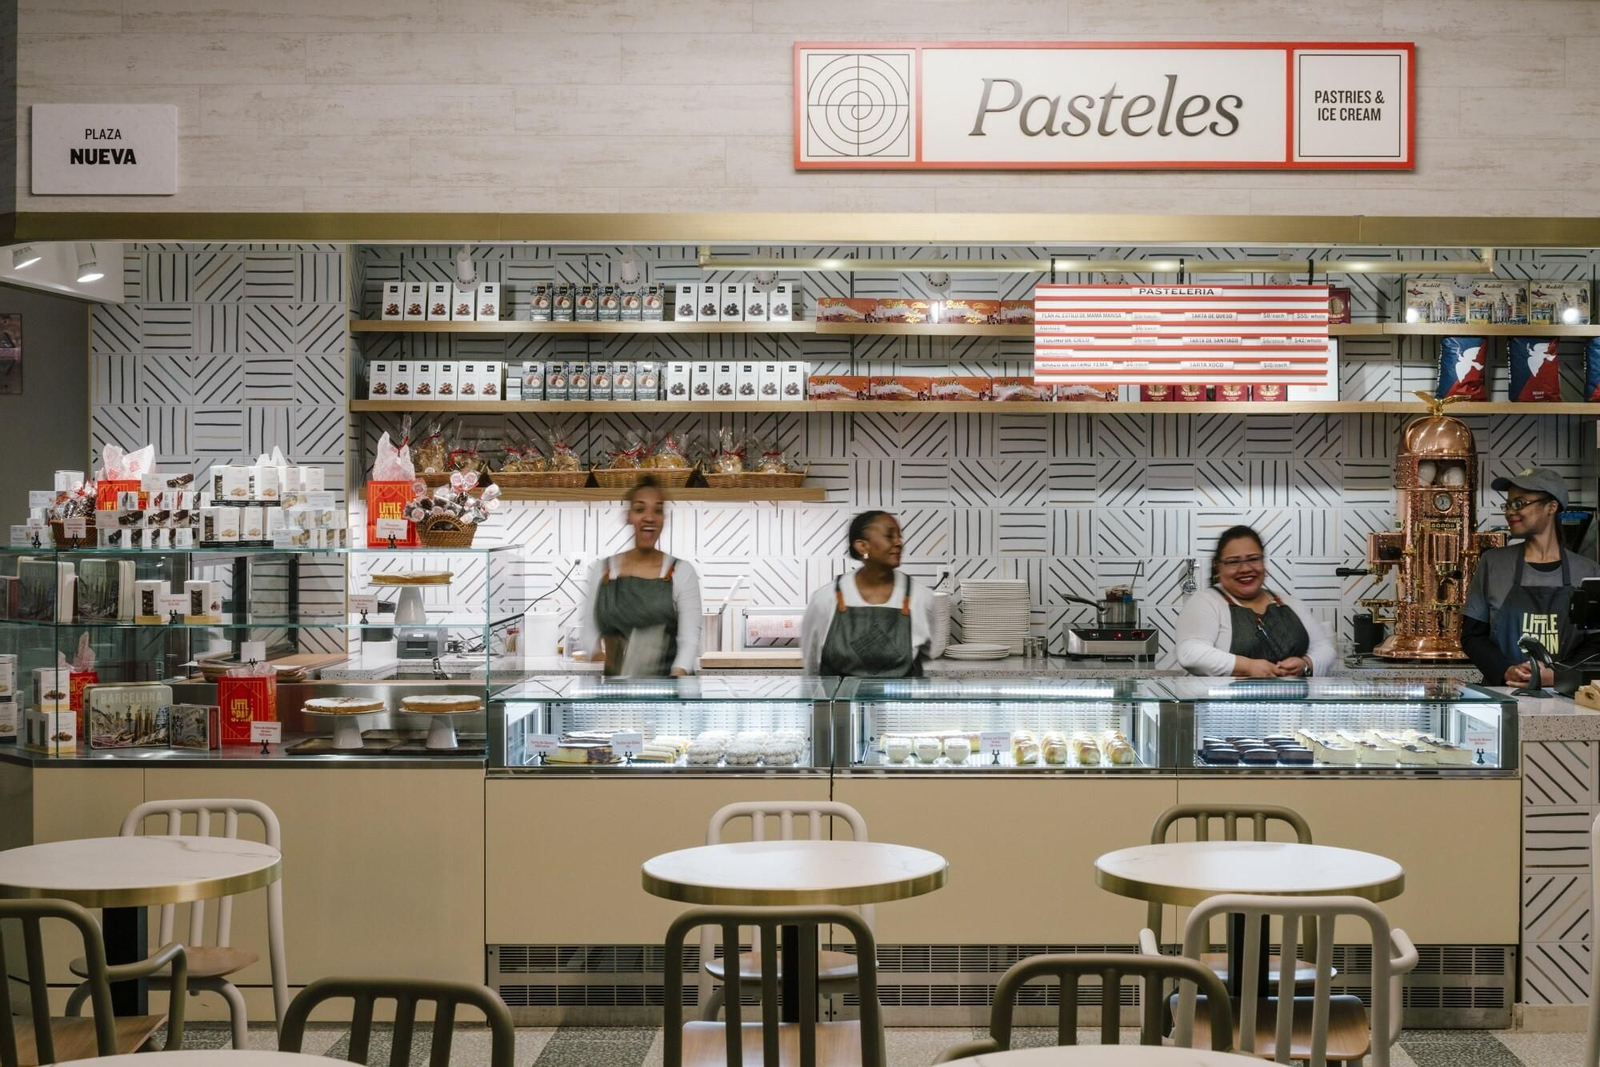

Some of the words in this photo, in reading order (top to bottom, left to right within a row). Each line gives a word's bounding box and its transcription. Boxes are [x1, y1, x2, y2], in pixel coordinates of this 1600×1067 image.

[1314, 90, 1372, 104] PASTRIES
[1374, 90, 1385, 104] &
[969, 74, 1243, 138] Pasteles
[1317, 107, 1337, 121] ICE
[1339, 107, 1381, 121] CREAM
[84, 128, 122, 141] PLAZA
[70, 147, 137, 166] NUEVA
[379, 502, 402, 513] LITTLE
[1522, 612, 1559, 633] LITTLE
[101, 692, 163, 705] BARCELONA
